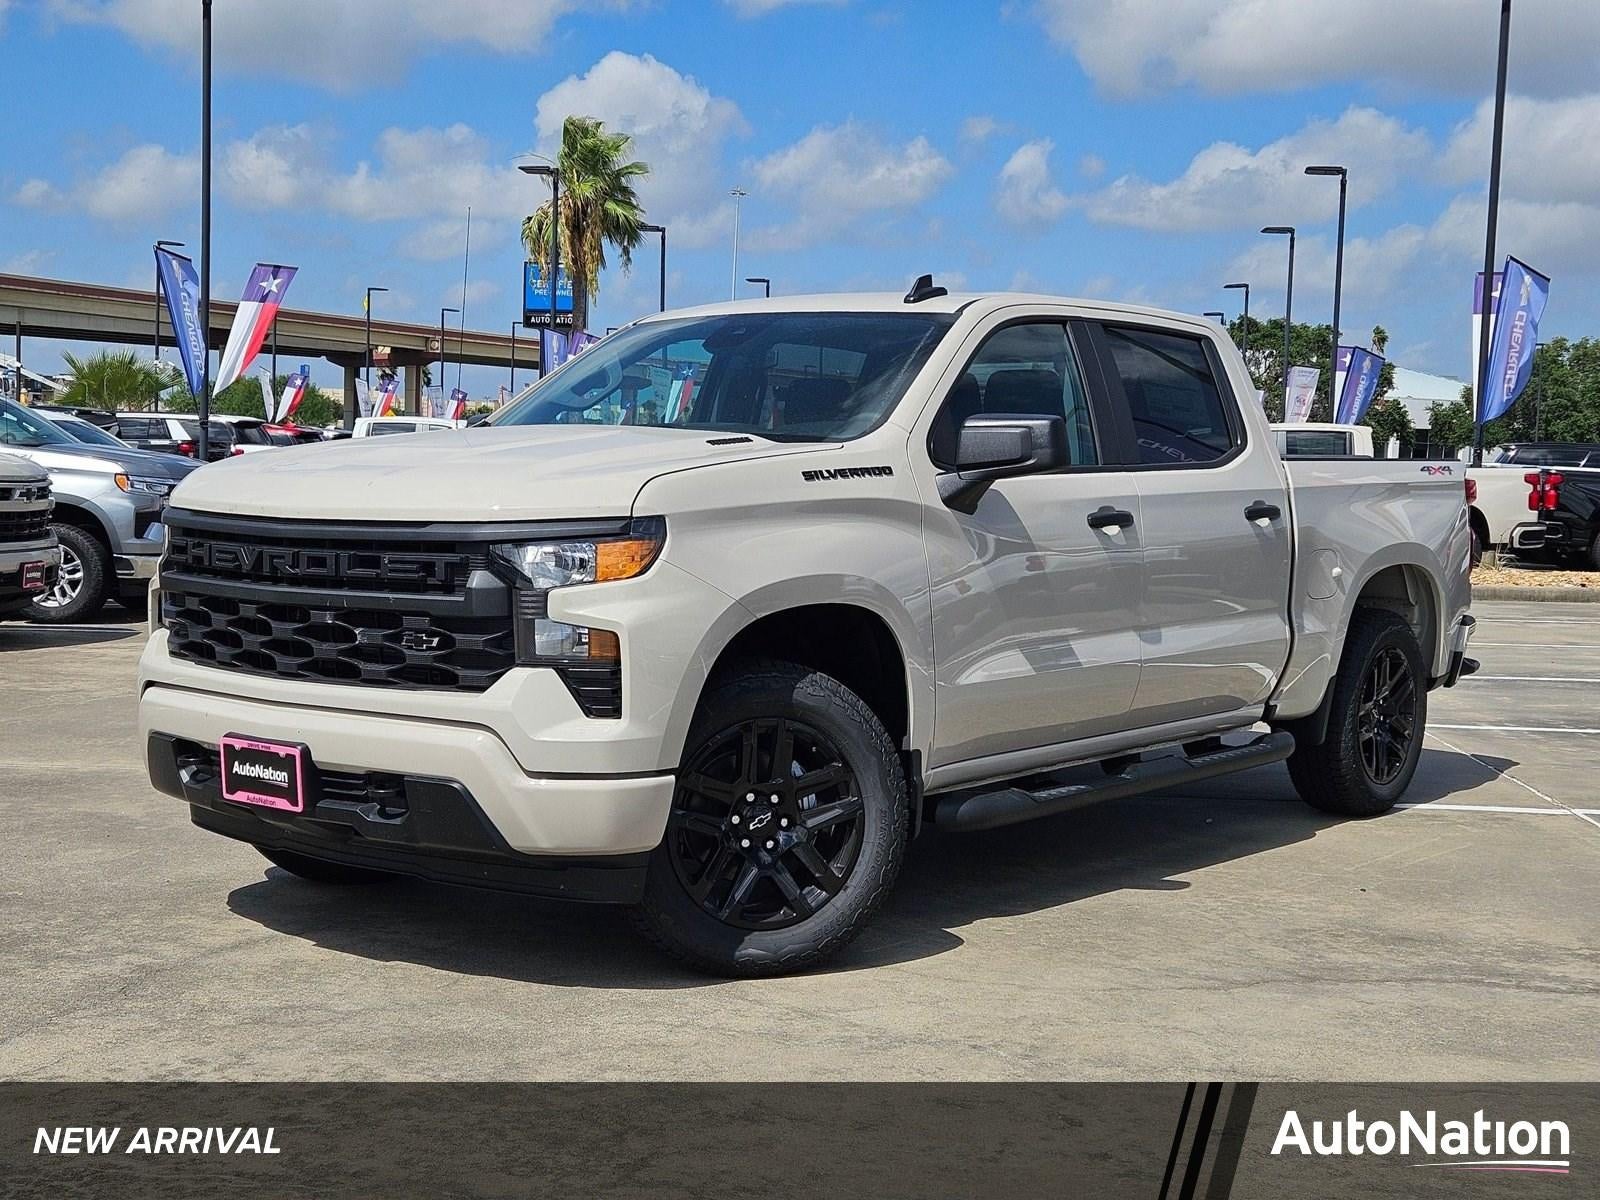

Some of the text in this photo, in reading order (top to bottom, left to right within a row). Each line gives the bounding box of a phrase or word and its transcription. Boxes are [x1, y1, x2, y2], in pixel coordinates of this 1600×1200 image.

[530, 316, 573, 324] AUTOATIO
[801, 465, 895, 482] SILVERADO
[168, 536, 465, 584] CHEVROLET
[232, 760, 289, 783] AutoNation
